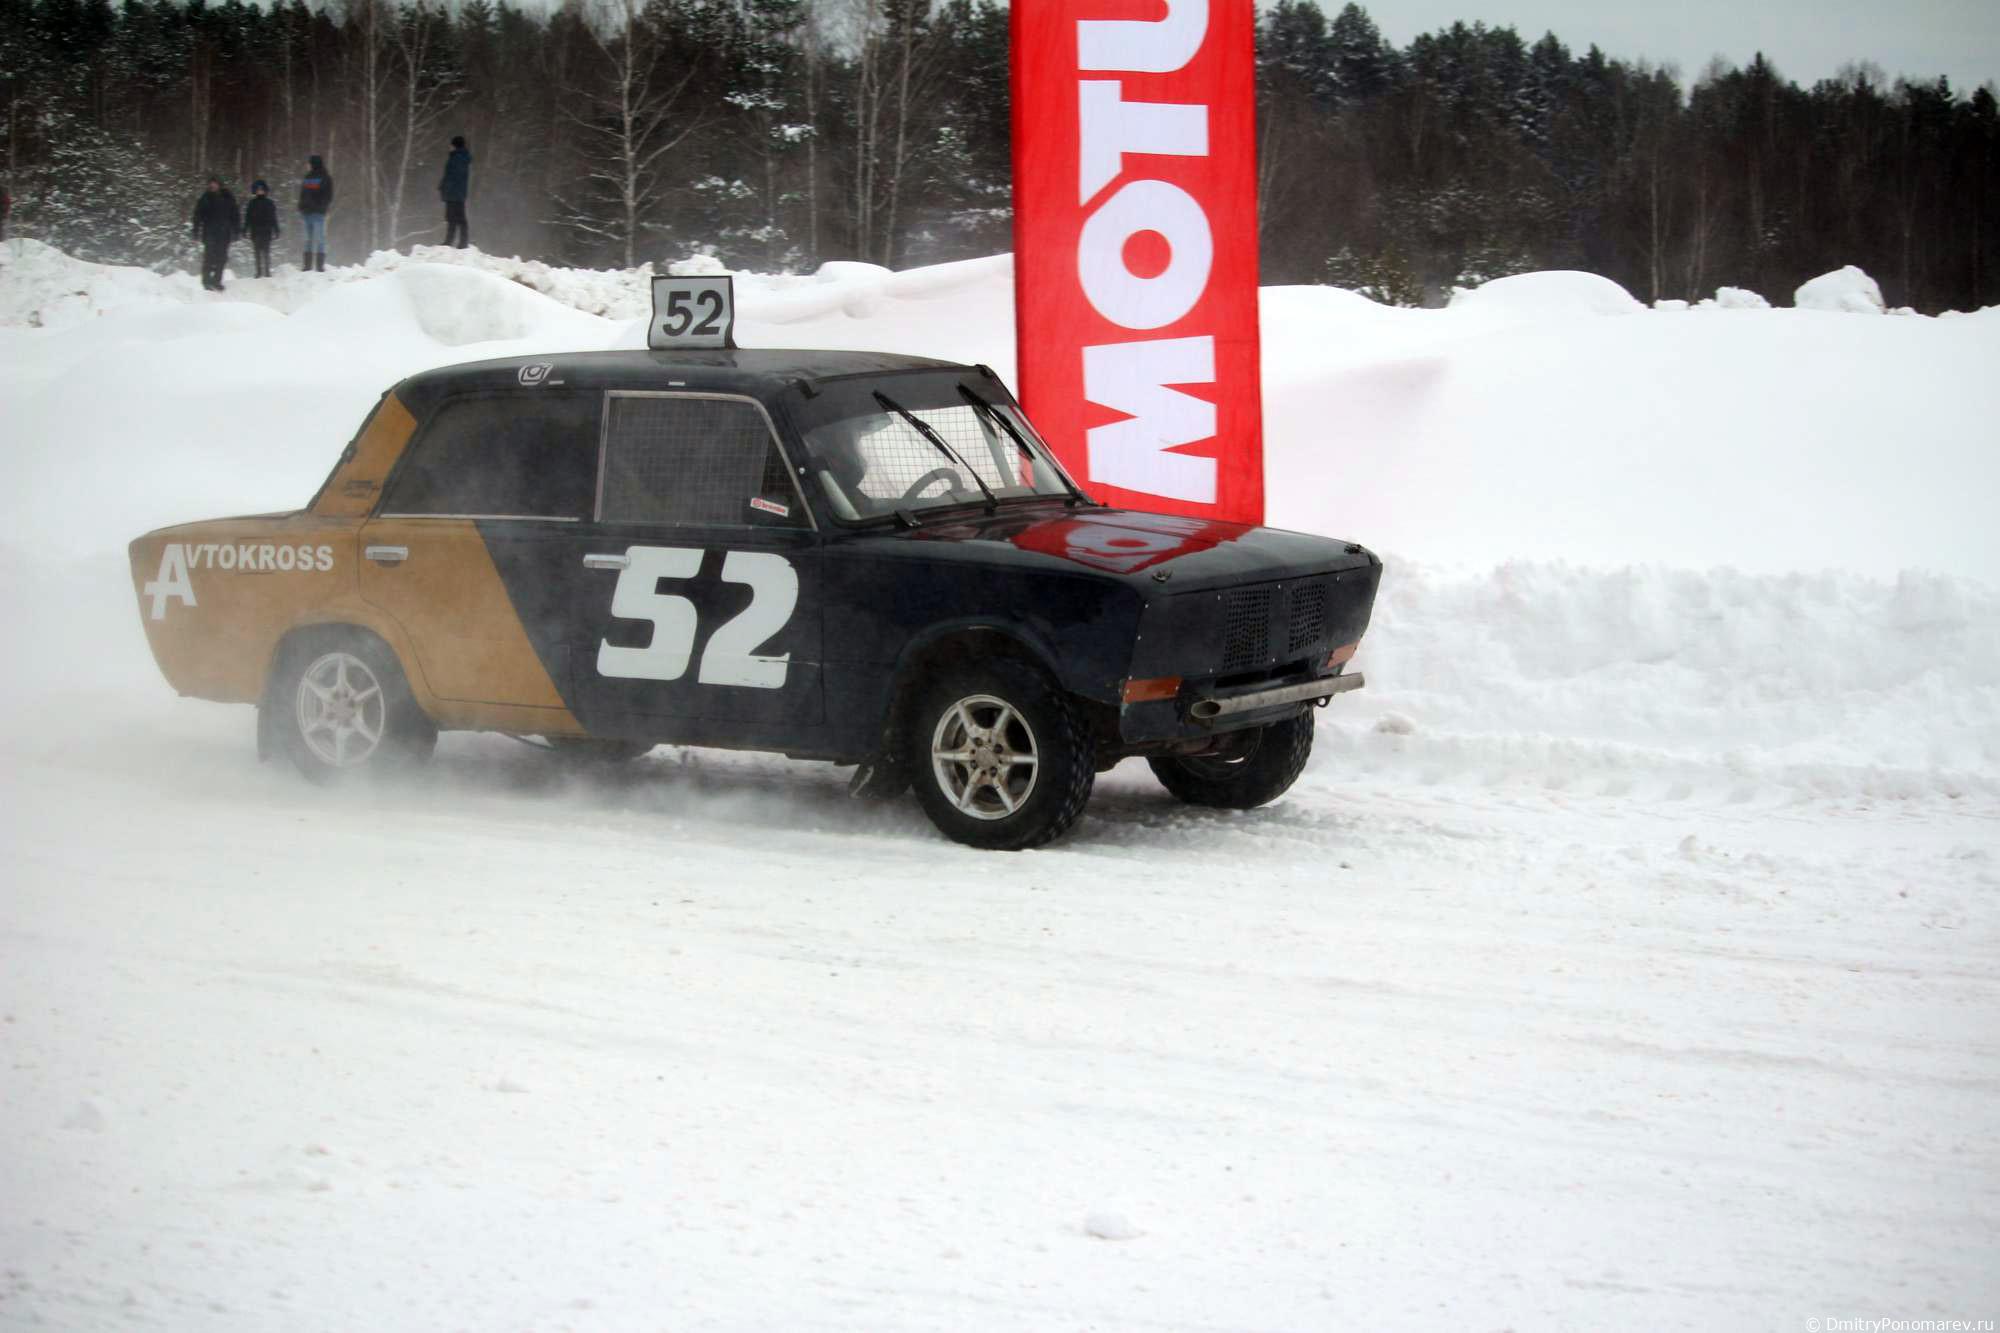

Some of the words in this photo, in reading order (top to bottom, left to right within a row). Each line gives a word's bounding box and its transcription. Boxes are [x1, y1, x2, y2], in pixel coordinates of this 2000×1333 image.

[663, 290, 723, 337] 52
[144, 543, 334, 620] AVTOKROSS
[597, 546, 798, 689] 52
